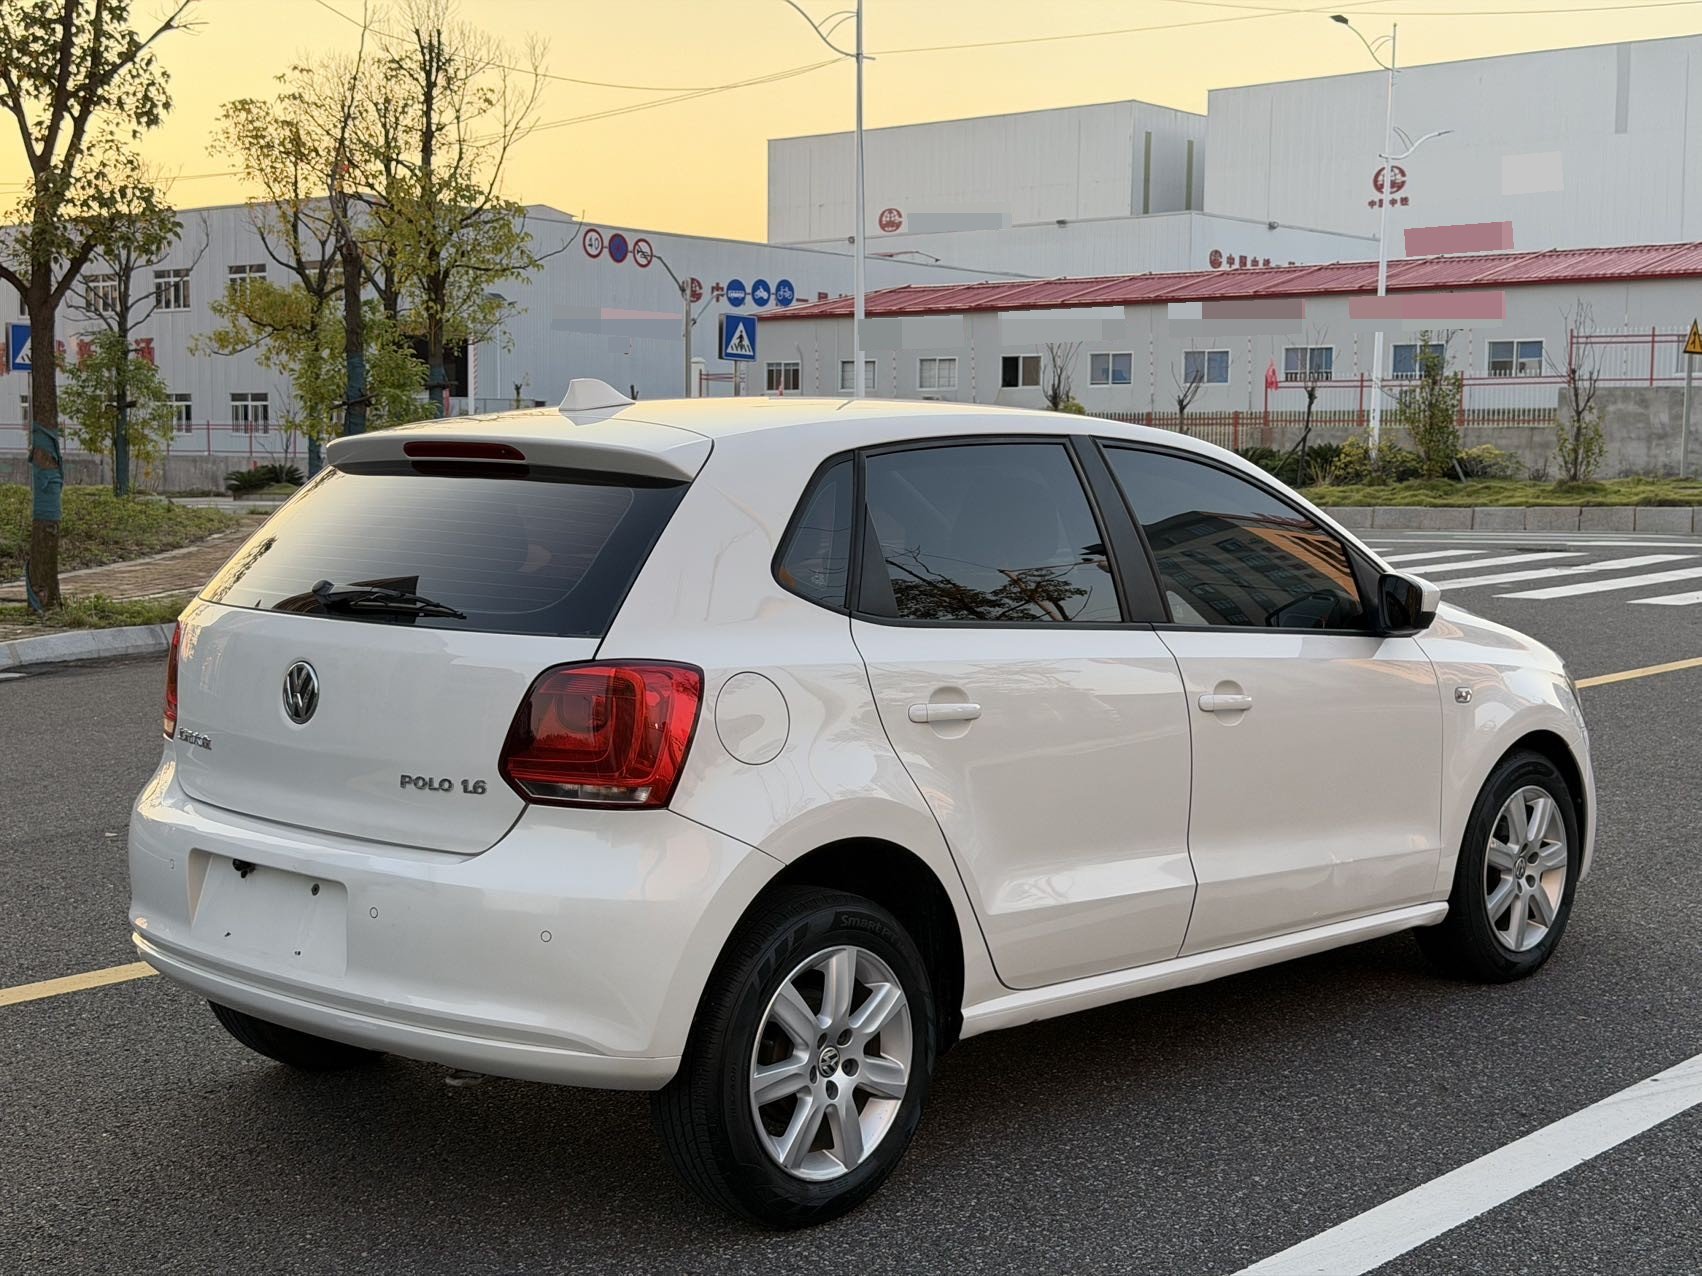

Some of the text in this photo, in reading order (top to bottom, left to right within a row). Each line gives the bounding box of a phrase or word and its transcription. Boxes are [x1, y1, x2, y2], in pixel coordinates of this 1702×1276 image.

[588, 236, 600, 250] 40
[400, 774, 487, 795] POLO 1.6
